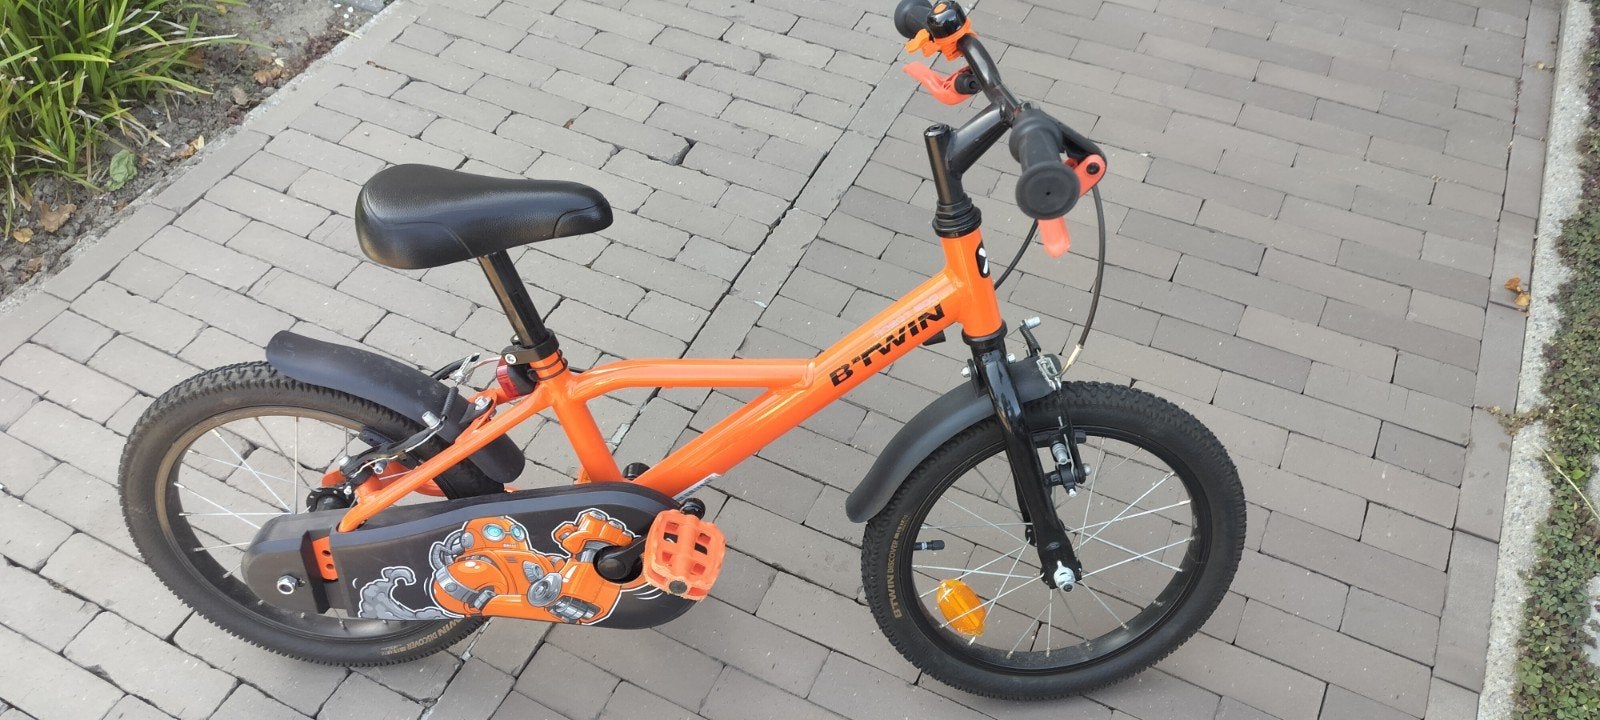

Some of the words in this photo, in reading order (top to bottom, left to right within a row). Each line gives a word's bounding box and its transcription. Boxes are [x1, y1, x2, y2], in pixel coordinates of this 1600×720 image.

[887, 540, 898, 573] DISCOVER
[438, 618, 461, 636] WIN
[407, 631, 438, 651] DISCOVER
